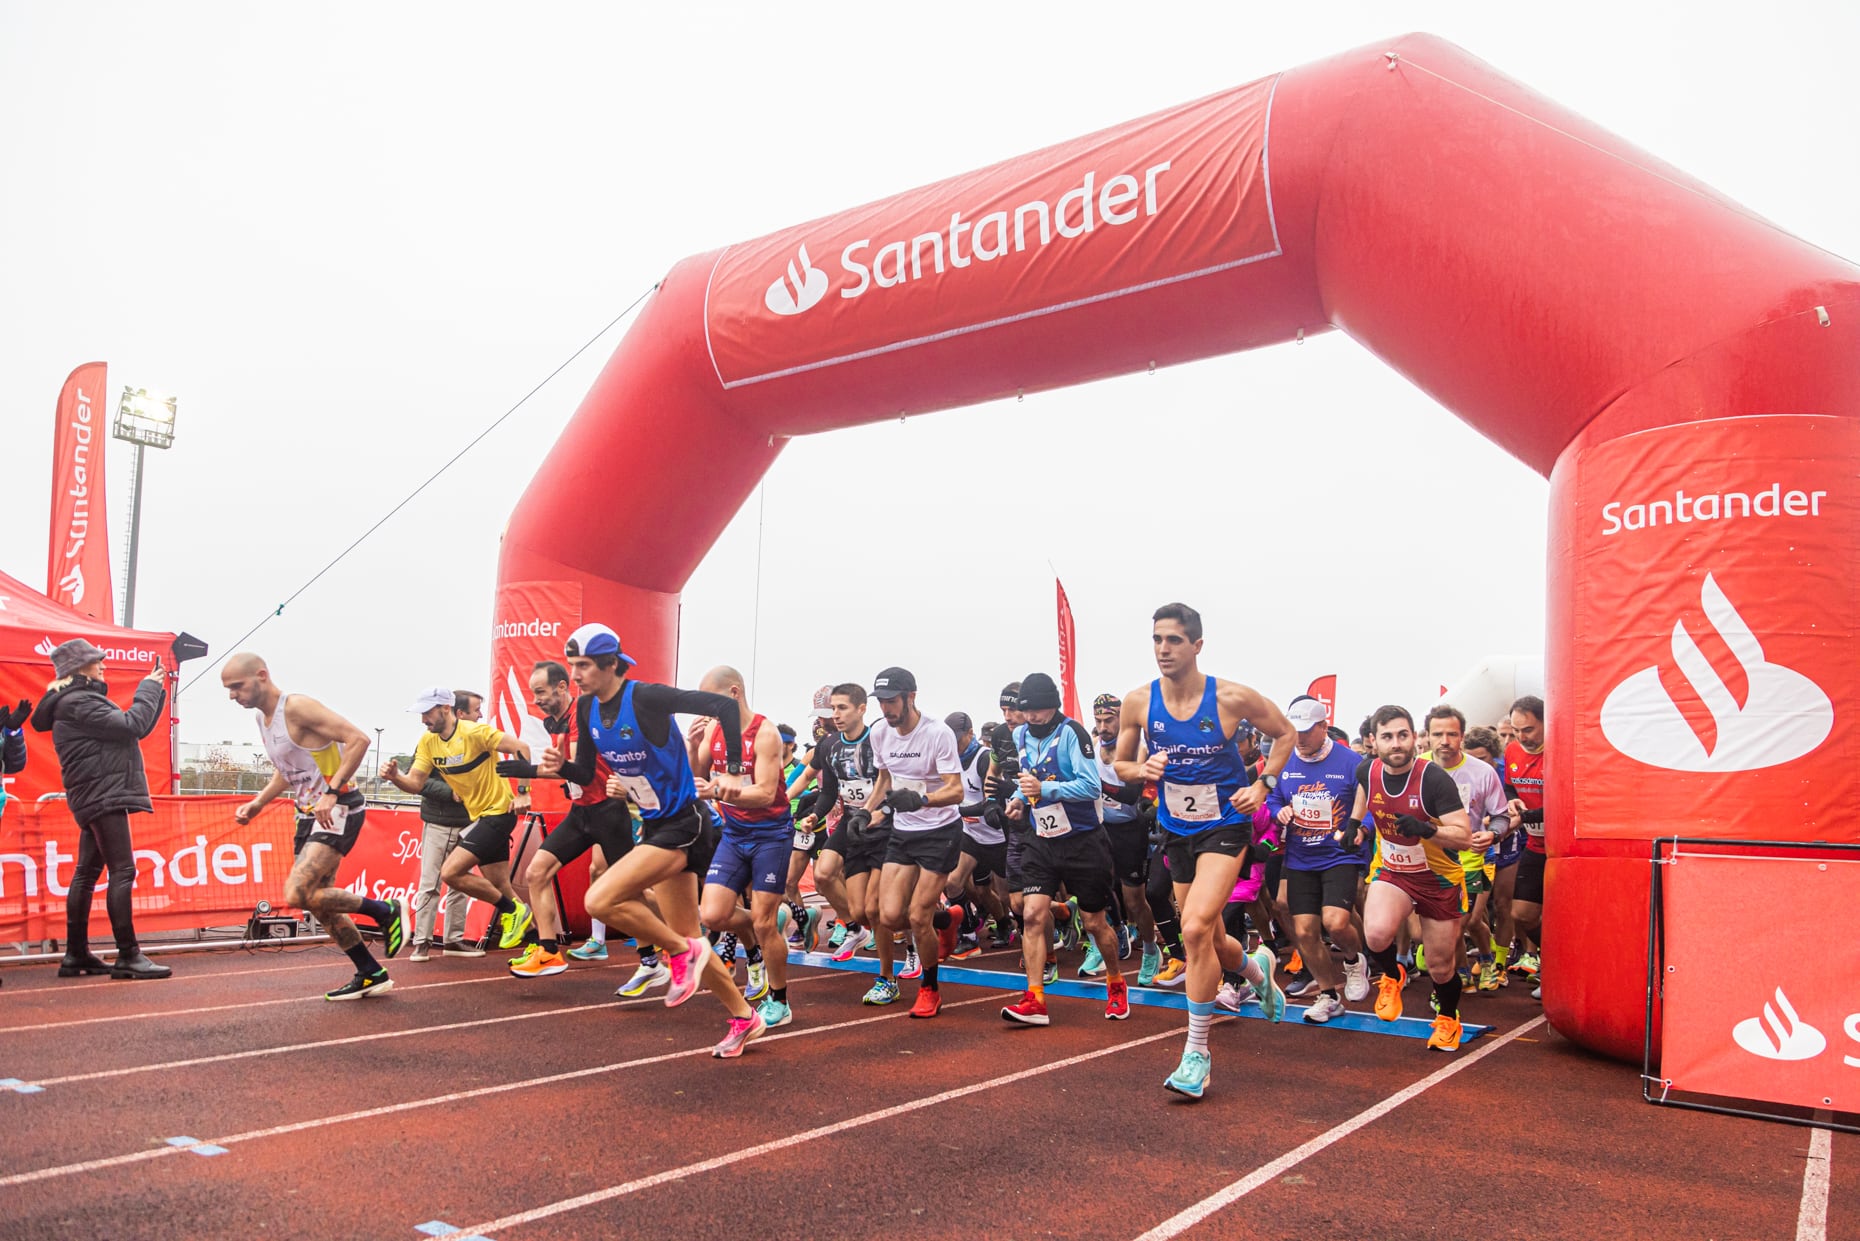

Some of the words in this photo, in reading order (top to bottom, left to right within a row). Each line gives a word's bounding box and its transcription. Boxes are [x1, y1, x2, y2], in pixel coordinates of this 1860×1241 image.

[840, 160, 1171, 299] Santander
[1602, 482, 1827, 536] Santander
[493, 617, 561, 640] antander
[97, 644, 156, 662] tander
[630, 786, 641, 800] 1
[847, 788, 865, 801] 35
[1184, 796, 1198, 812] 2
[1300, 808, 1321, 819] 439
[1040, 815, 1058, 830] 32
[801, 834, 810, 844] 15
[1389, 853, 1412, 863] 401
